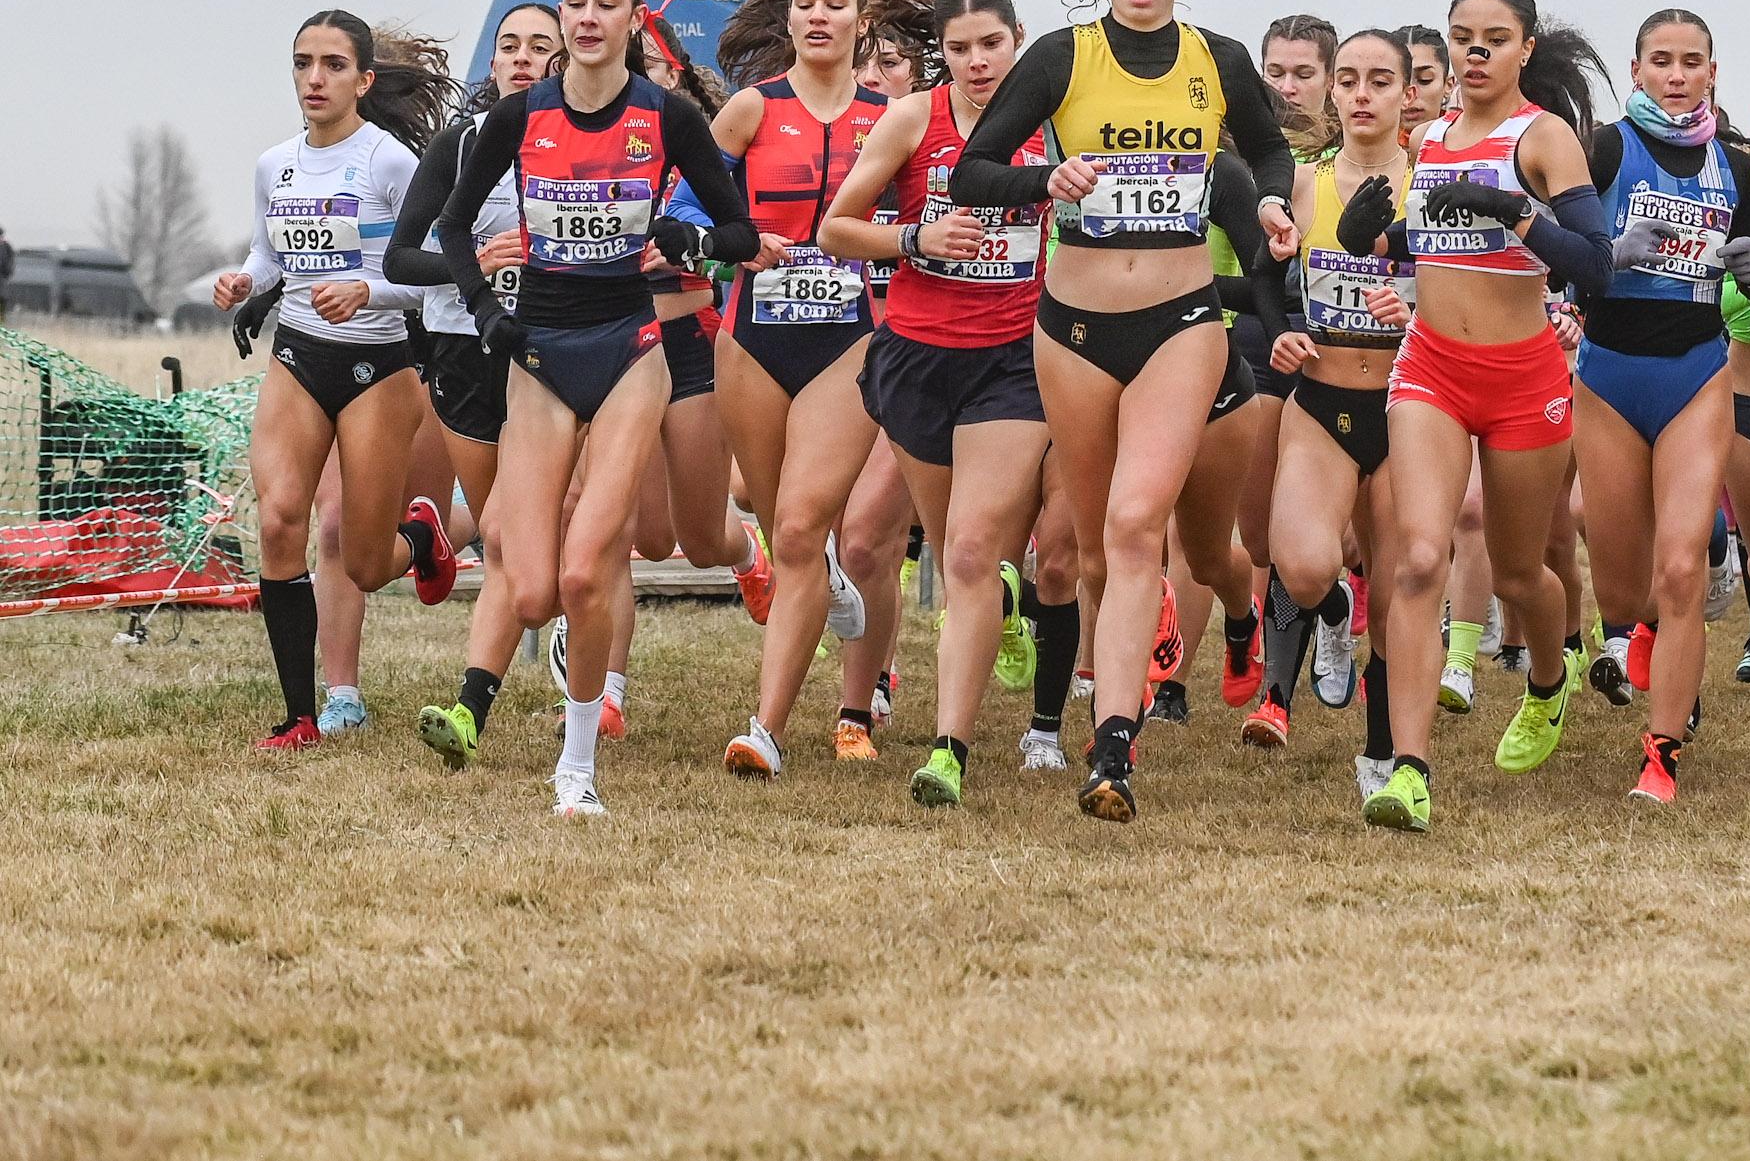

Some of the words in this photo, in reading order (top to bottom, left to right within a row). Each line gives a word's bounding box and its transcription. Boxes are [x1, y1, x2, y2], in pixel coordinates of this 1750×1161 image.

[1100, 120, 1203, 150] teika
[1096, 155, 1159, 165] DIPUTACIÓN
[1106, 165, 1159, 174] URGOS
[537, 182, 599, 192] DIPUTACIÓN
[1116, 176, 1159, 187] Ibercaja
[536, 191, 599, 200] BURGOS
[1111, 190, 1181, 214] 1162
[1634, 195, 1703, 215] DIPUTACIÓN
[556, 204, 599, 214] Ibercaja
[1632, 203, 1704, 227] BURGOS
[284, 217, 315, 227] Ibercaja
[551, 216, 622, 239] 1863
[282, 229, 335, 250] 1992
[778, 258, 824, 266] UGOS
[1321, 252, 1379, 266] DIPUTACIÓN
[786, 267, 823, 277] Ibercaja
[1320, 260, 1379, 274] BURGOS
[1338, 273, 1378, 285] Ibercaja
[781, 279, 842, 302] 1862
